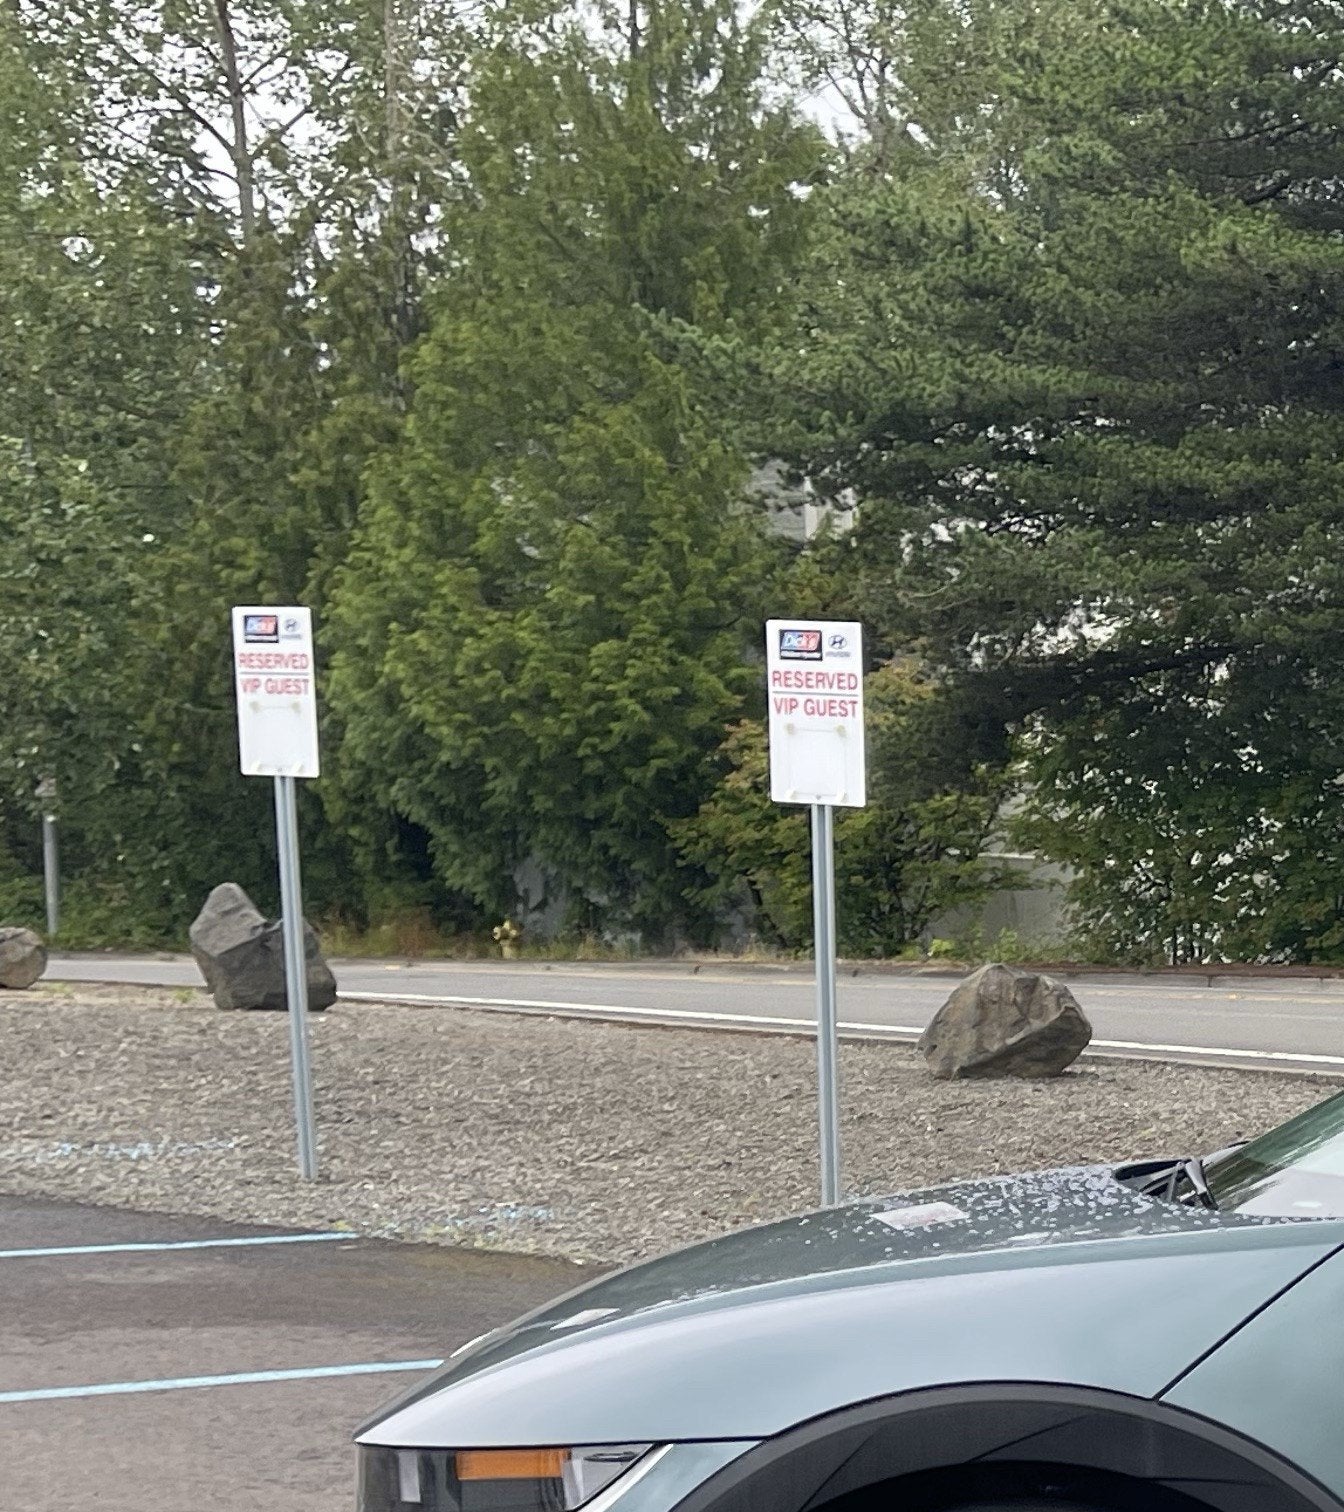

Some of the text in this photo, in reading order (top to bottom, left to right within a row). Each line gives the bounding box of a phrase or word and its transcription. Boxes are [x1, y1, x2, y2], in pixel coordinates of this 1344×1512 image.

[238, 652, 309, 669] RESERVED
[240, 677, 309, 694] VIP GUEST
[771, 670, 857, 690] RESERVED
[773, 697, 858, 717] VIP GUEST
